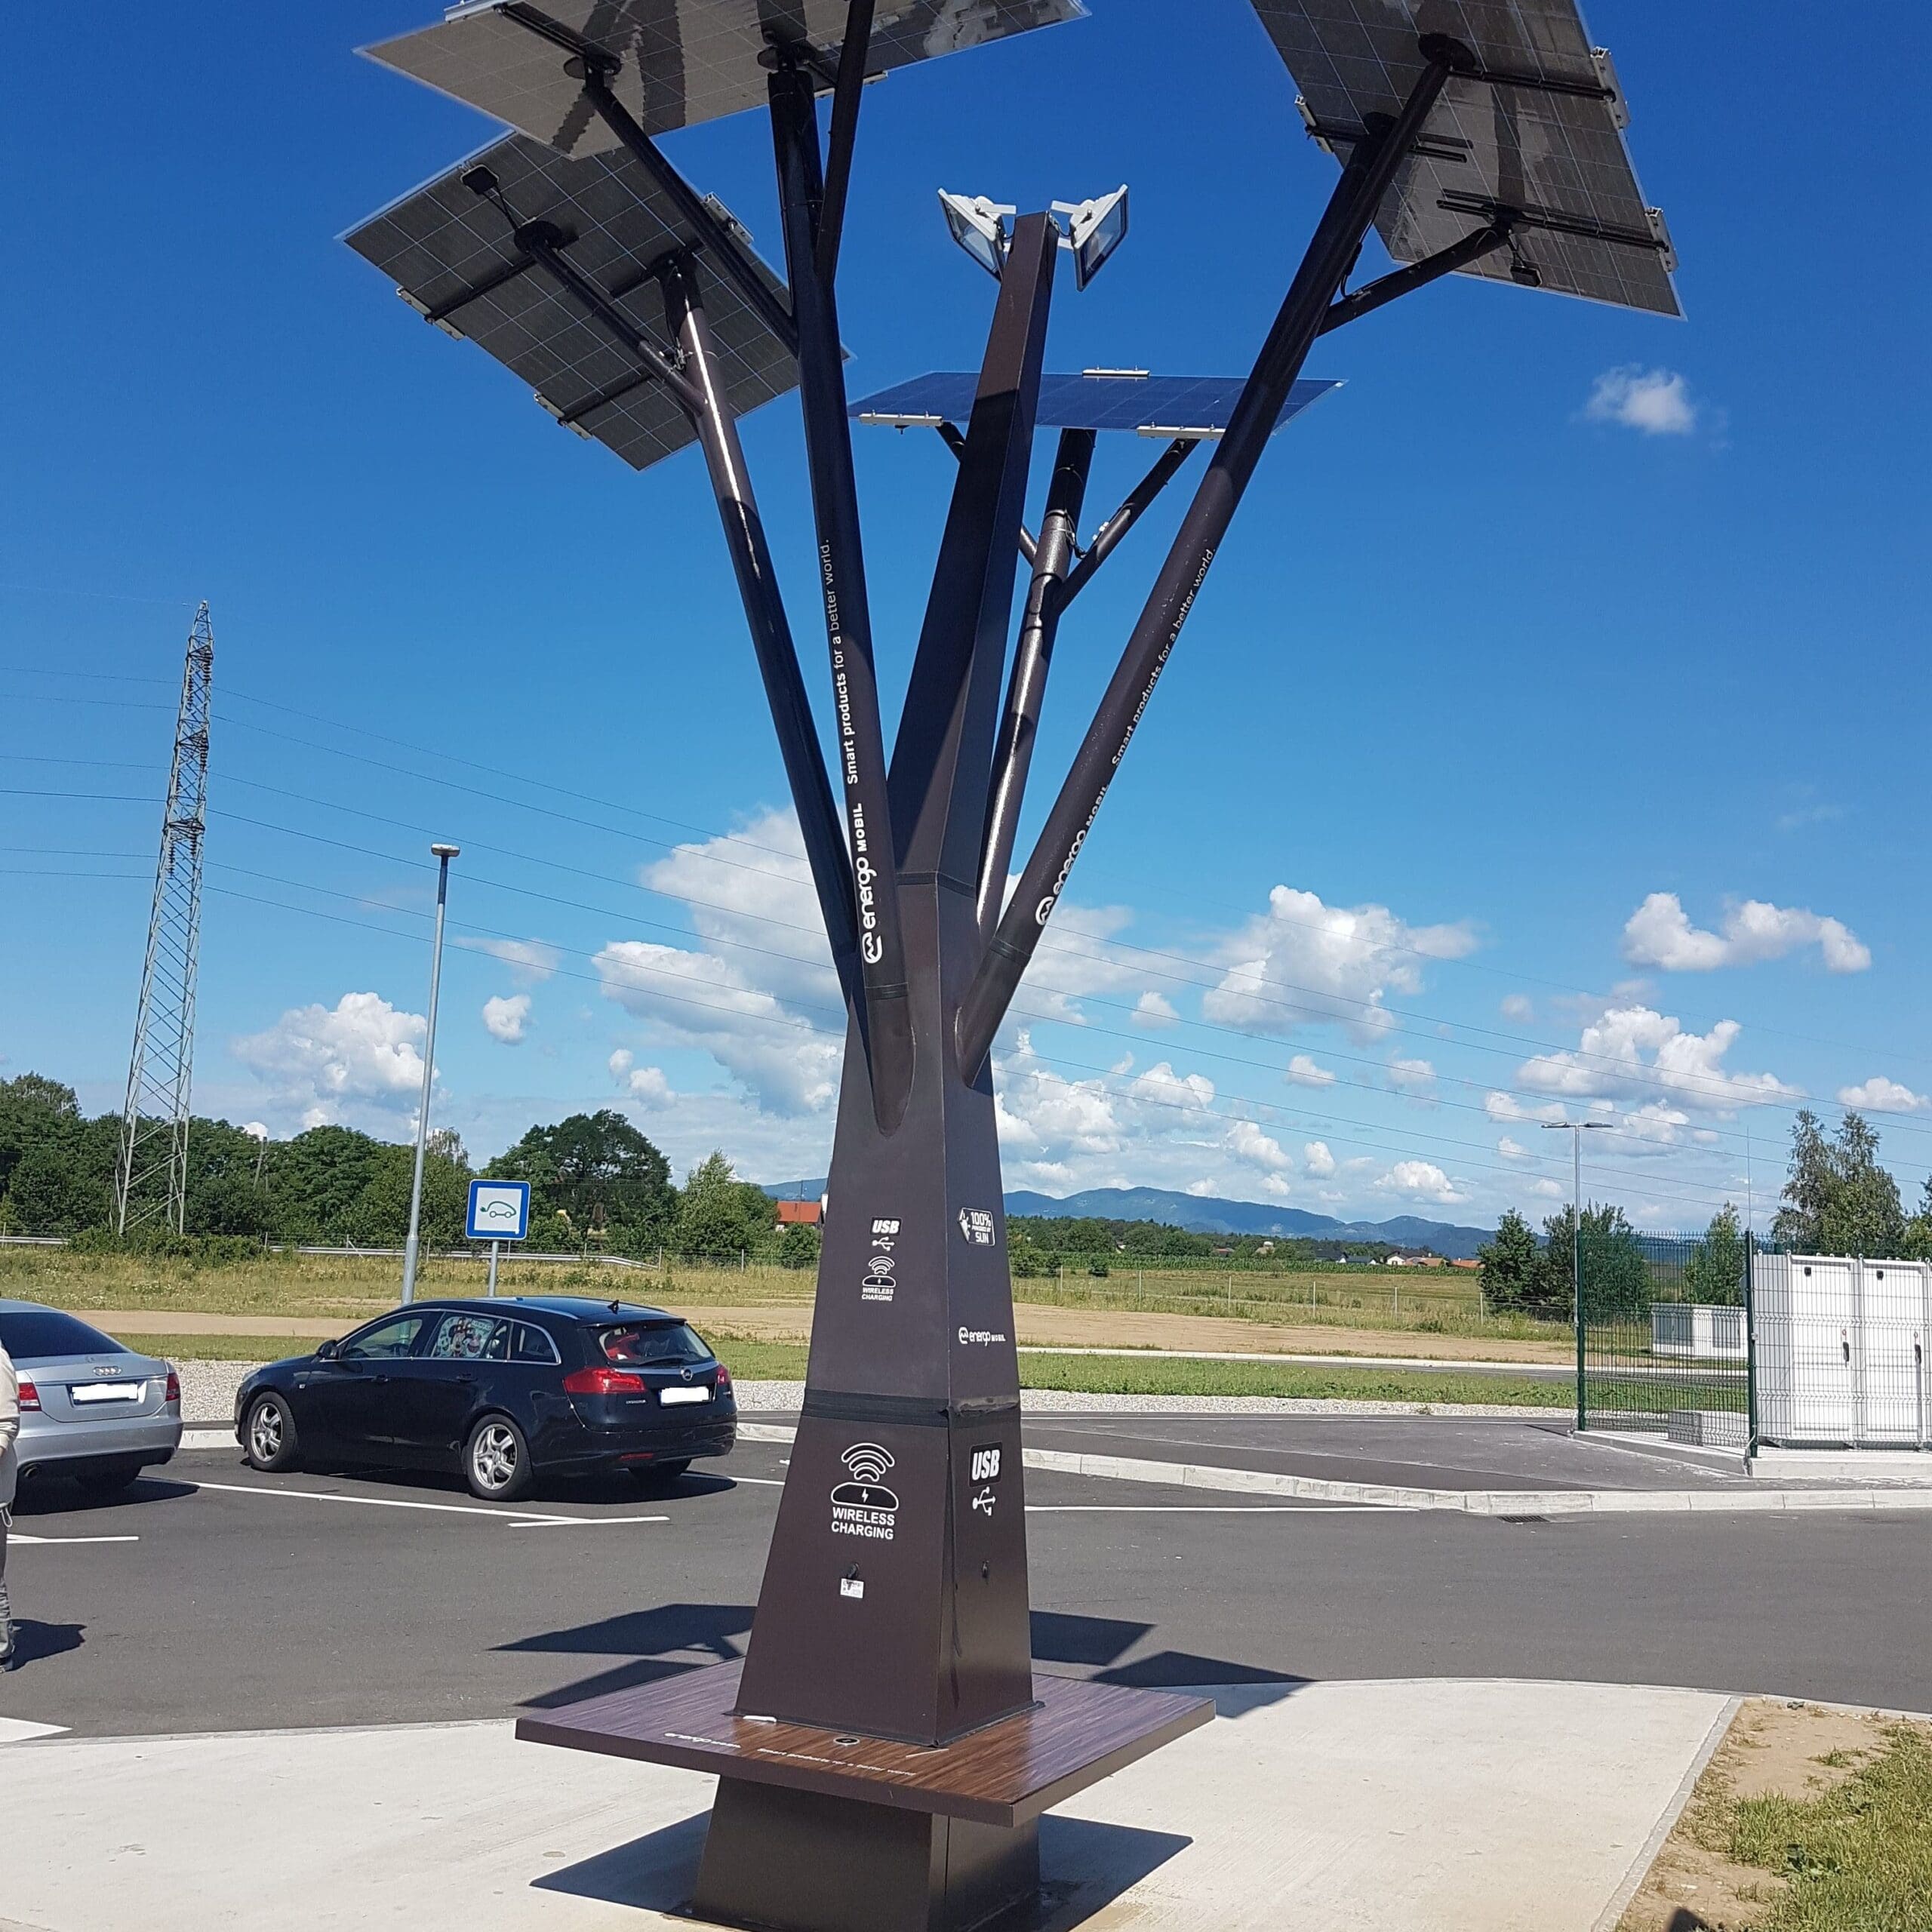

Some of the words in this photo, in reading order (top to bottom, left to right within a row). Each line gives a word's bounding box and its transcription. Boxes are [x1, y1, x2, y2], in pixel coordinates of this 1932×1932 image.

[820, 538, 832, 586] world.
[827, 591, 839, 633] better
[1172, 589, 1195, 630] better
[832, 635, 841, 645] a
[1169, 632, 1177, 642] a
[833, 649, 844, 669] for
[1158, 643, 1171, 663] for
[836, 672, 856, 737] products
[1132, 666, 1162, 725] products
[1112, 724, 1134, 767] Smart
[844, 740, 858, 785] Smart
[853, 803, 867, 852] MOBIL
[856, 857, 878, 930] energo
[872, 1220, 900, 1234] USB
[971, 1211, 992, 1227] 100%
[975, 1232, 989, 1244] SUN
[862, 1287, 894, 1295] WIRELESS
[969, 1331, 991, 1346] energo
[971, 1449, 1001, 1481] USB
[832, 1506, 895, 1526] WIRELESS
[831, 1521, 894, 1540] CHARGING
